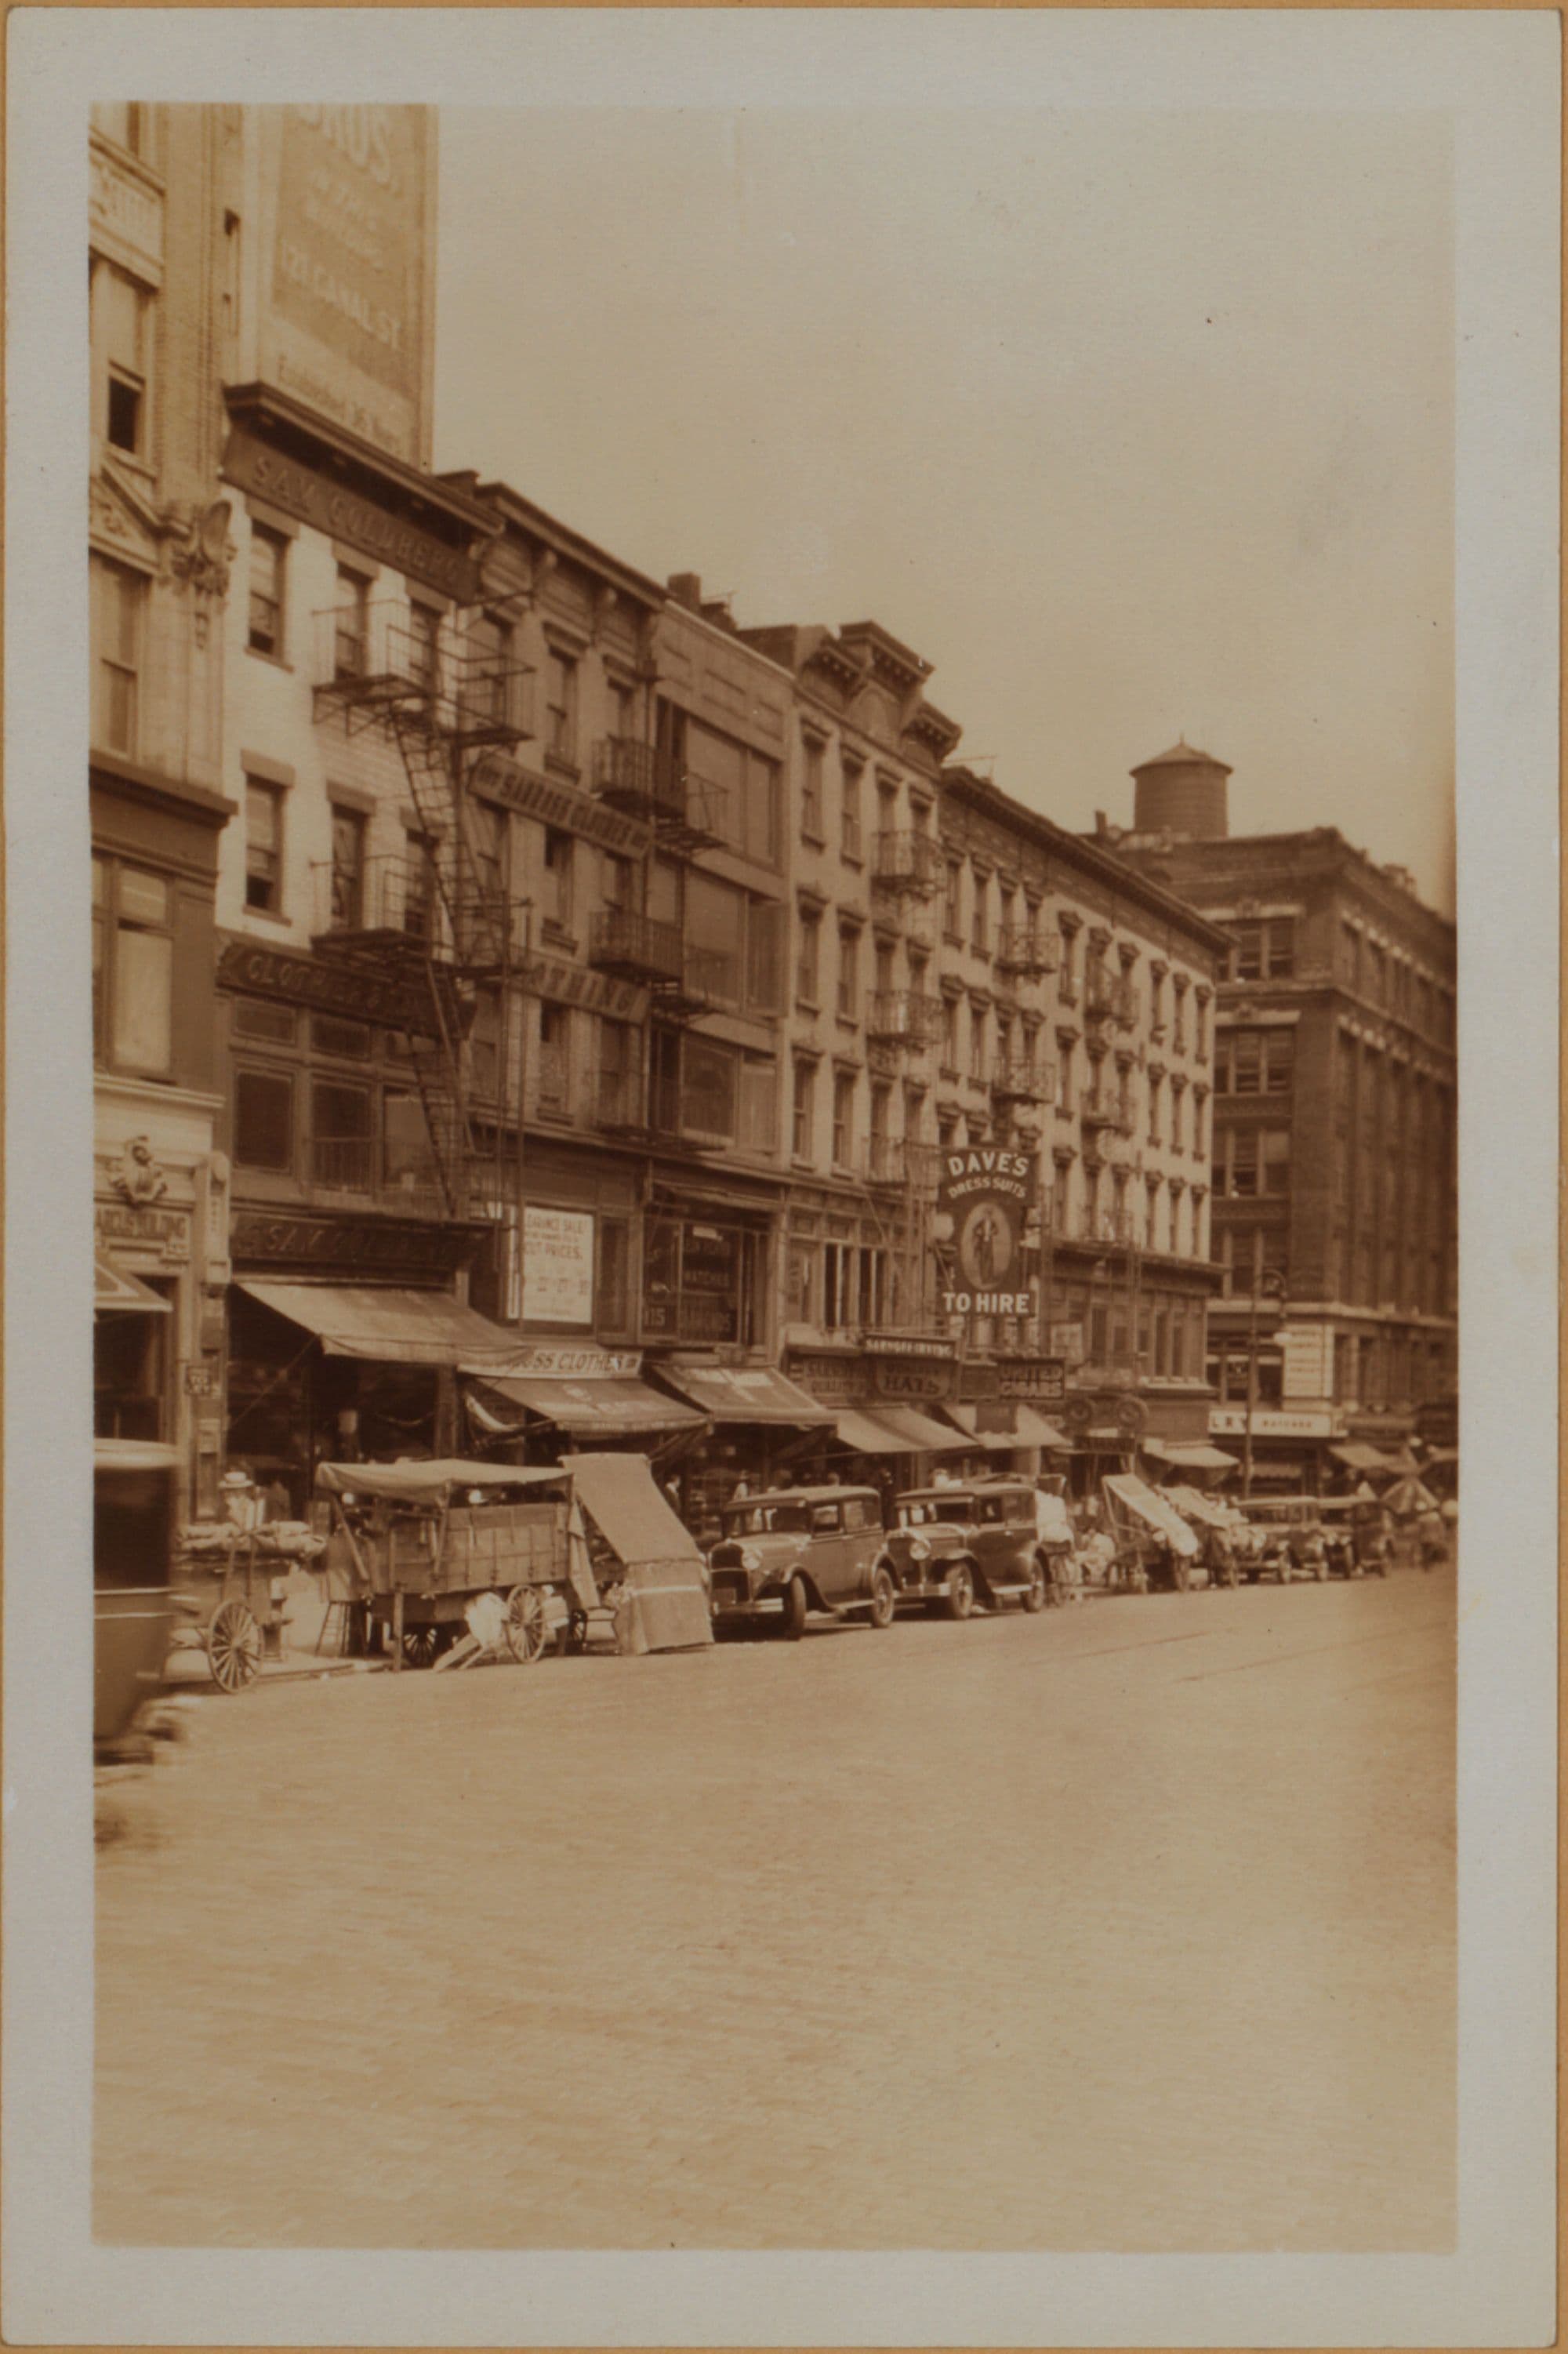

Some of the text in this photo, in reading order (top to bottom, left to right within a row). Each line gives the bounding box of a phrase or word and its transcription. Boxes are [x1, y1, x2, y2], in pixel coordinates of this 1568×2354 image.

[948, 1151, 1029, 1178] DAVE'S
[947, 1176, 1028, 1199] DRESS SUITS
[942, 1291, 1030, 1314] TO HIRE
[884, 1375, 940, 1395] HATS
